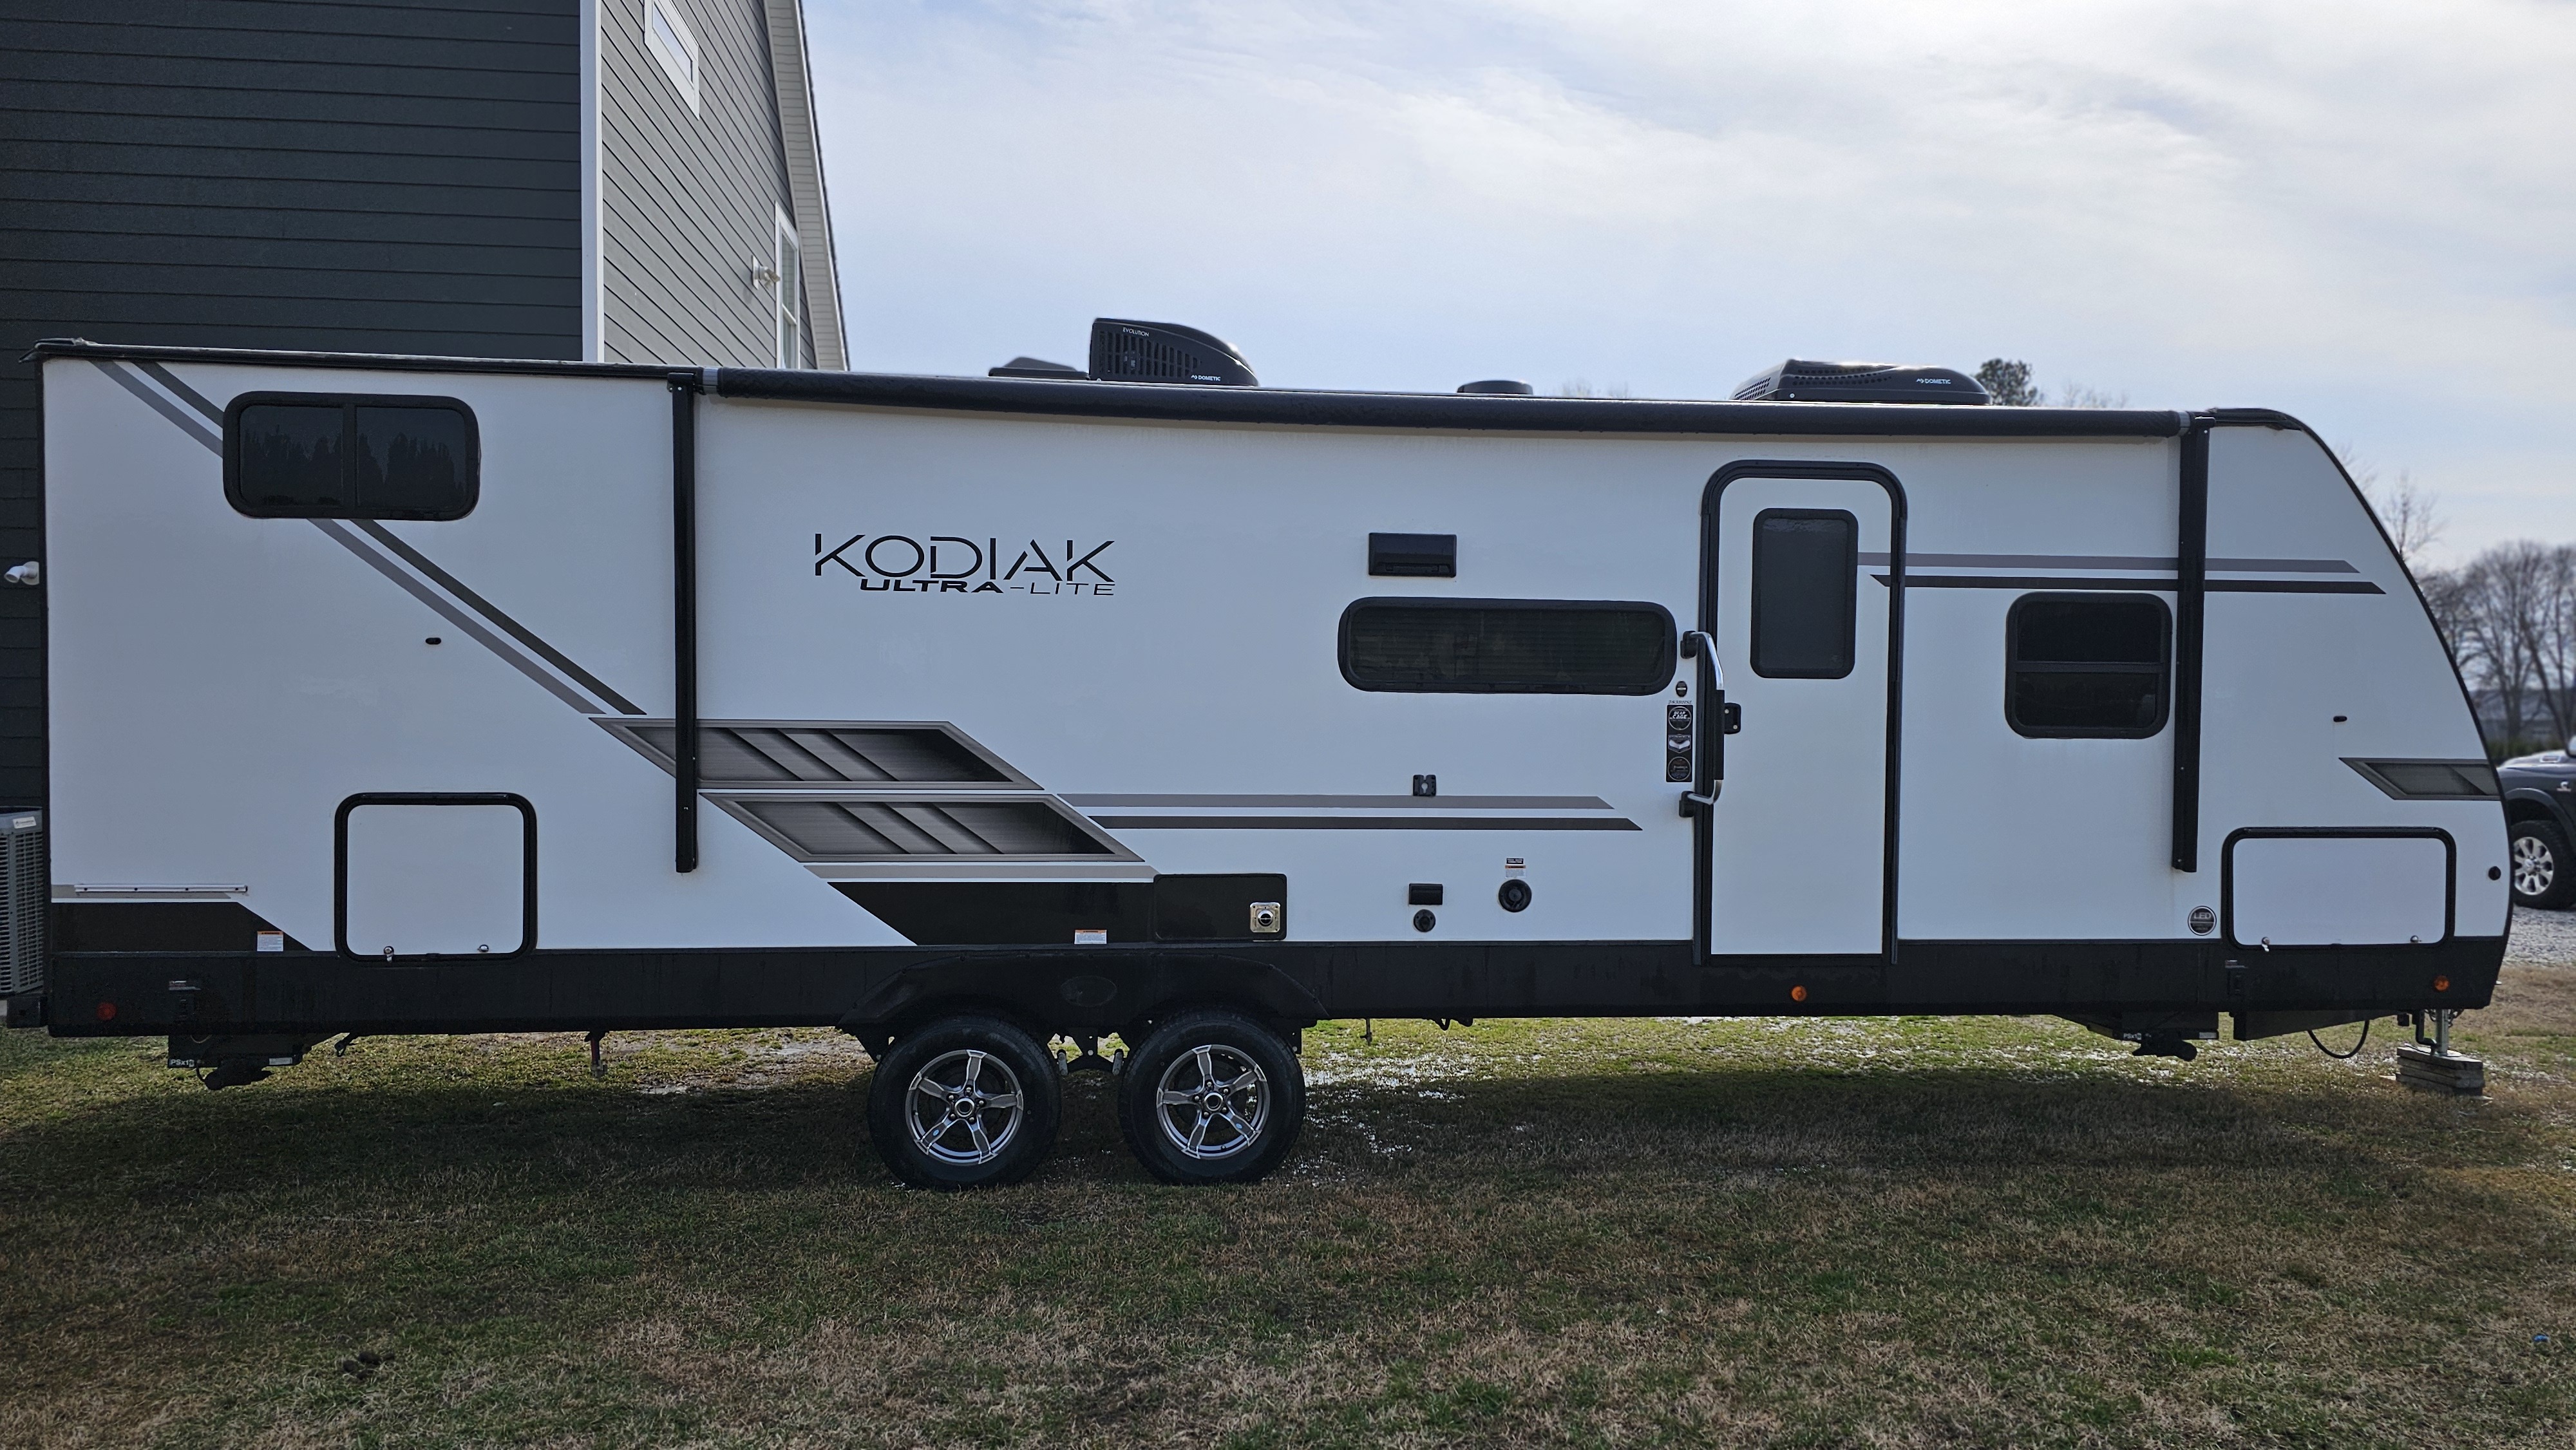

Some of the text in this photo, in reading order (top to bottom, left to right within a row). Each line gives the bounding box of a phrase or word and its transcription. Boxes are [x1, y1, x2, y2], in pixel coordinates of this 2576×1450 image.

[1122, 326, 1150, 337] EVOLUTION
[814, 533, 1115, 582] KODIAK
[860, 578, 1115, 596] ULTRA-LITE
